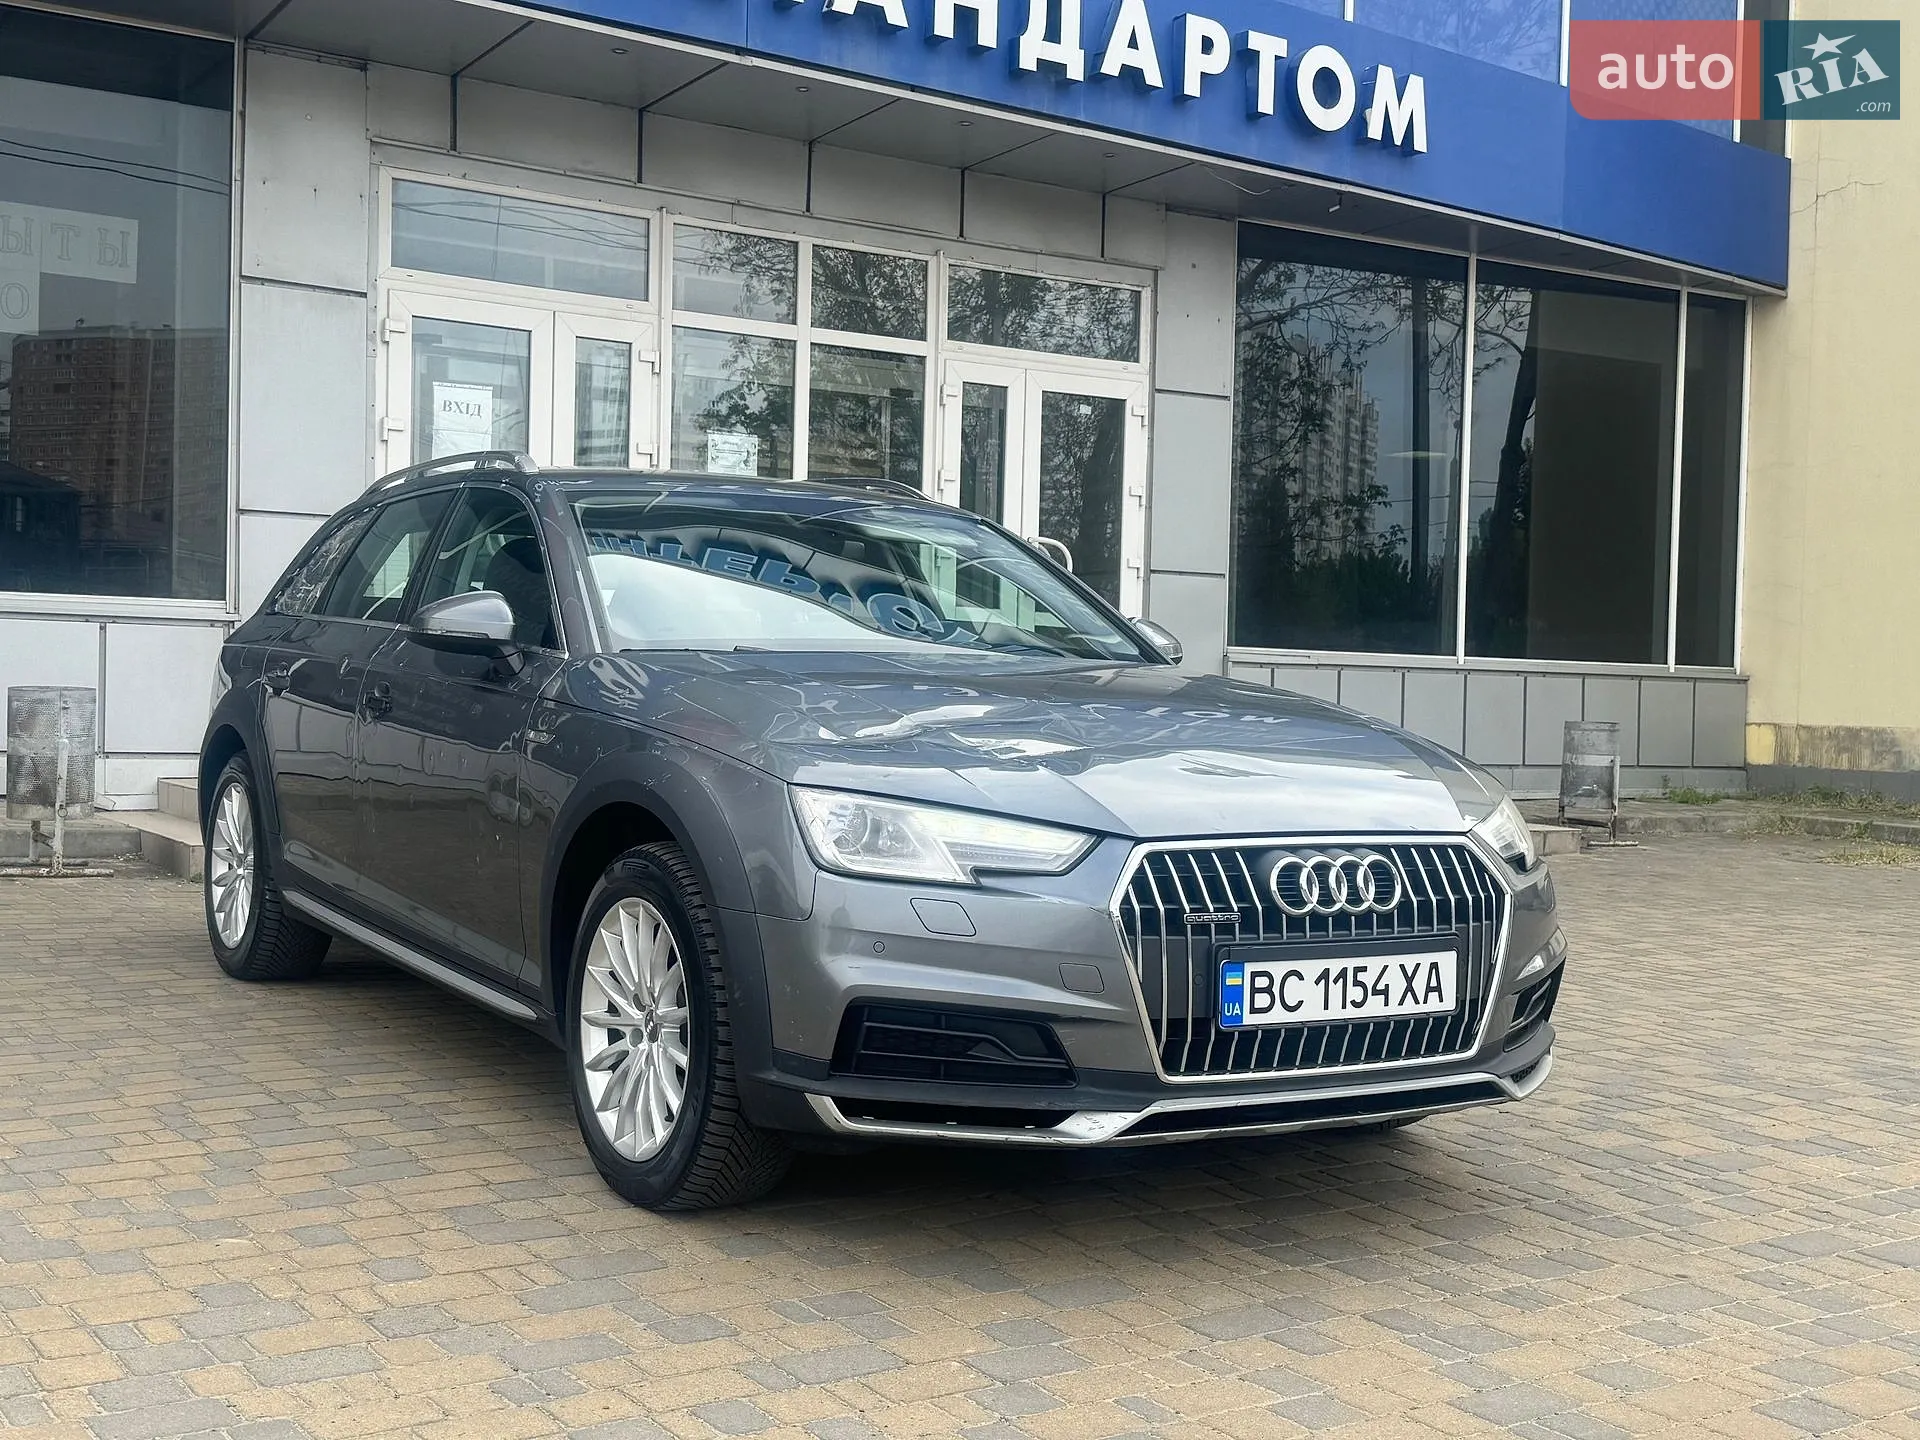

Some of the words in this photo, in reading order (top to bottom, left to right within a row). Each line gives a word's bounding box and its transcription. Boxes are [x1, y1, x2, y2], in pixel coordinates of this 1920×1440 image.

[441, 399, 482, 419] ВХІД
[1186, 914, 1239, 924] quattro
[1314, 965, 1390, 1011] 1154
[1224, 1002, 1241, 1016] UA
